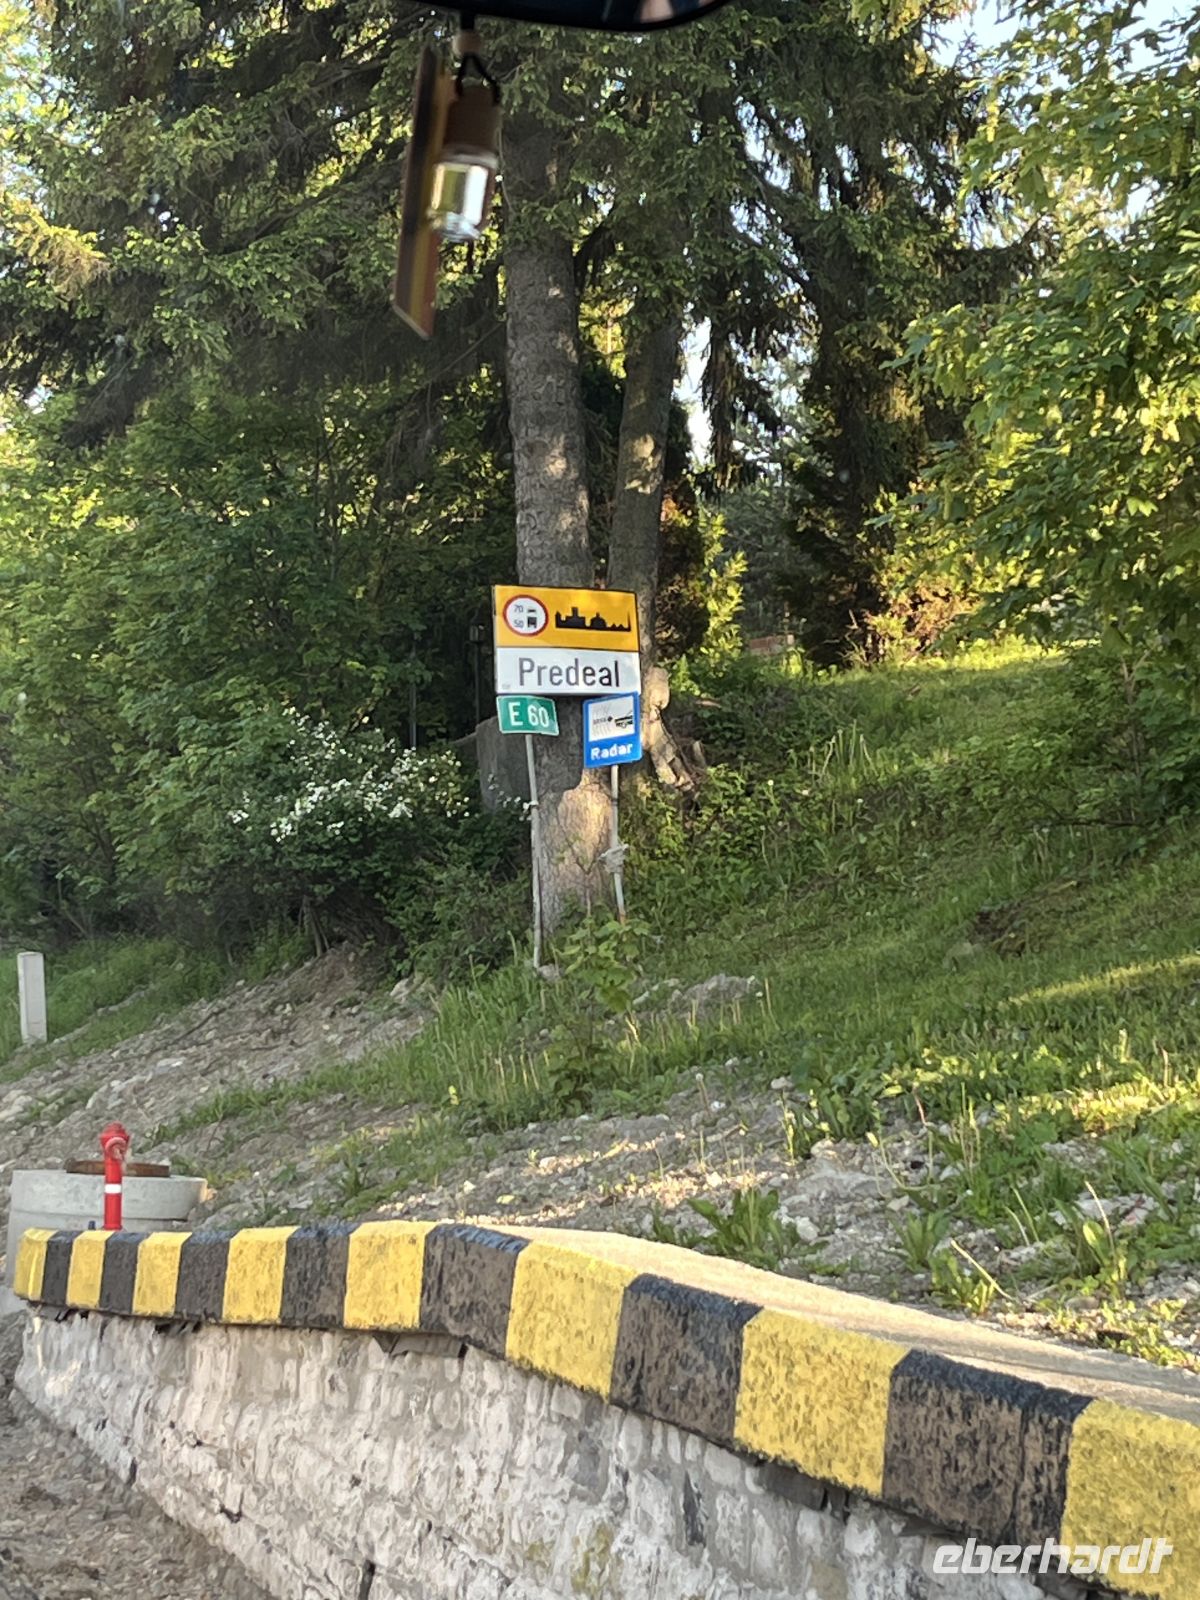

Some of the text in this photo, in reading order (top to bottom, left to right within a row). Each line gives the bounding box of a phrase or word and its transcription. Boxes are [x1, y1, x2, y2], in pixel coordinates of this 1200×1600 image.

[514, 604, 524, 613] 70
[514, 619, 524, 629] 50
[518, 657, 620, 687] Predeal
[508, 702, 549, 727] E 60
[591, 743, 633, 760] Radar
